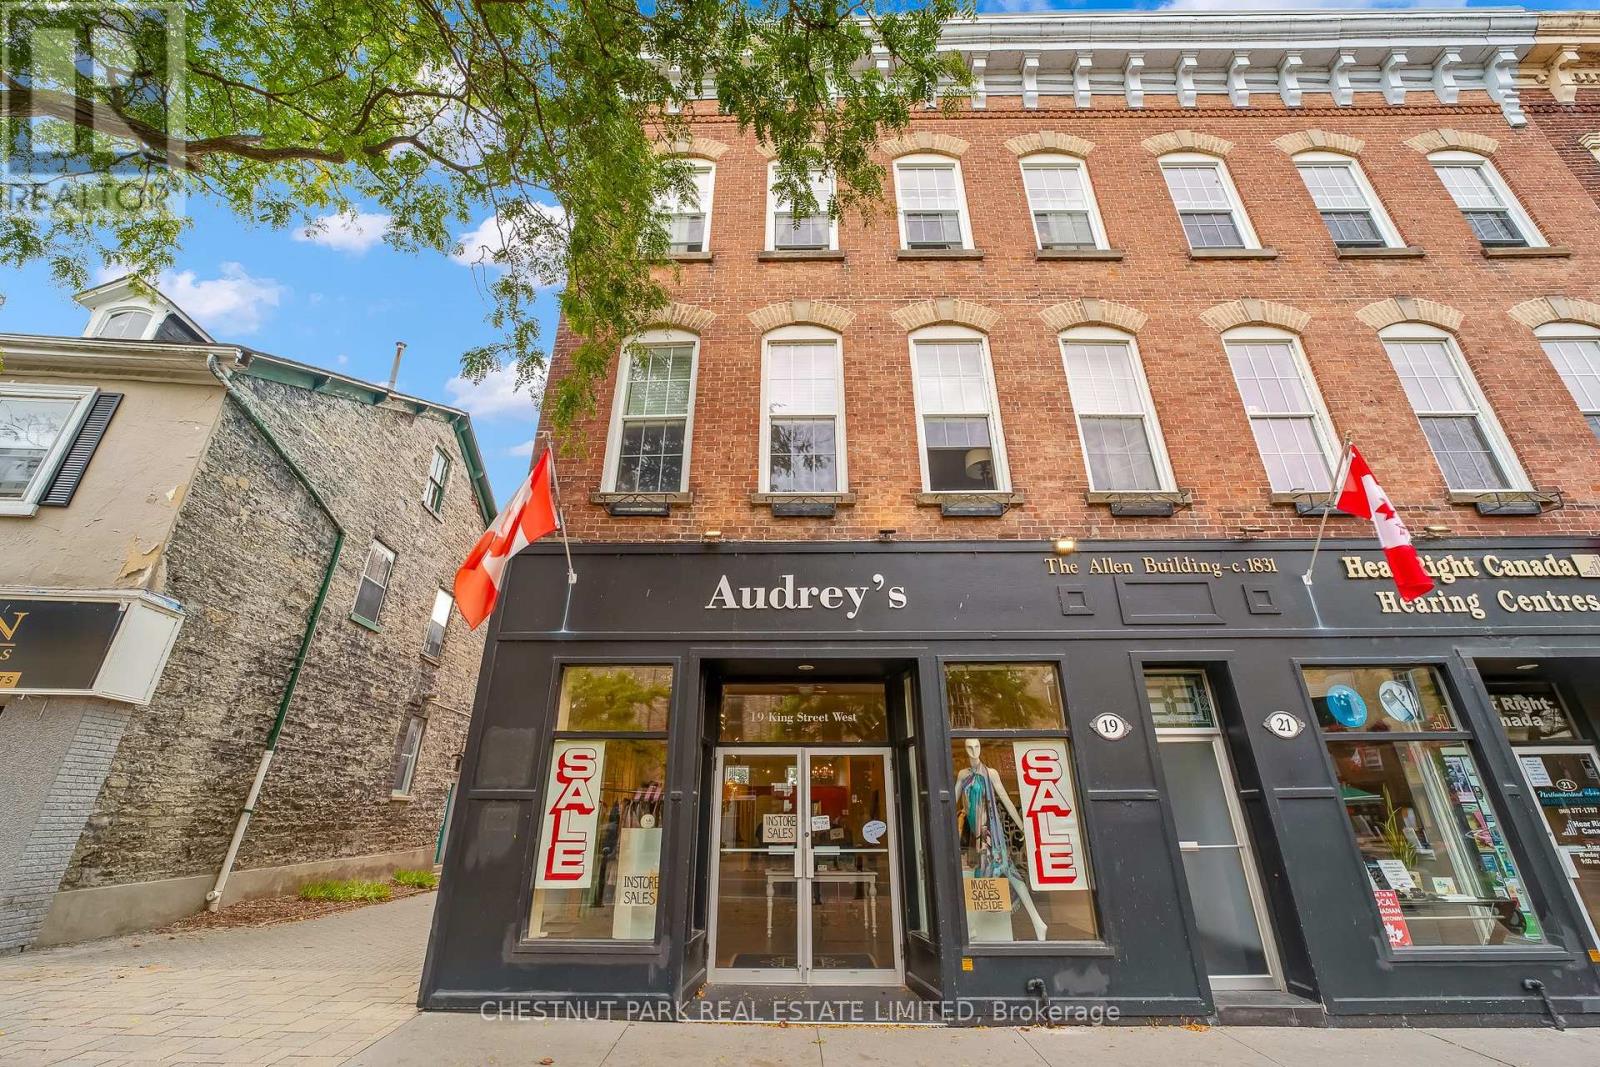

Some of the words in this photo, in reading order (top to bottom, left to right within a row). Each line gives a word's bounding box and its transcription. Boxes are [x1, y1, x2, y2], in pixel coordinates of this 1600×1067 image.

[1044, 557, 1079, 575] The
[1089, 557, 1133, 574] Allen
[1342, 556, 1393, 578] Hea
[1483, 553, 1578, 577] Canada
[705, 573, 907, 619] Audrey's
[1375, 590, 1486, 619] Hearing
[1497, 589, 1600, 613] Centres
[750, 711, 765, 722] 19
[768, 711, 794, 725] King
[796, 711, 829, 722] Street
[832, 711, 858, 722] West
[1277, 717, 1292, 732] 21
[1101, 718, 1118, 734] 19
[1560, 781, 1572, 789] 21
[544, 747, 597, 881] SALE
[765, 815, 797, 827] INSTORE
[1021, 748, 1078, 885] SALE
[767, 827, 794, 839] SALES
[623, 875, 660, 890] INSTORE
[970, 879, 997, 890] MORE
[623, 891, 656, 906] SALES
[971, 888, 1000, 901] SALES
[973, 900, 1004, 911] INSIDE
